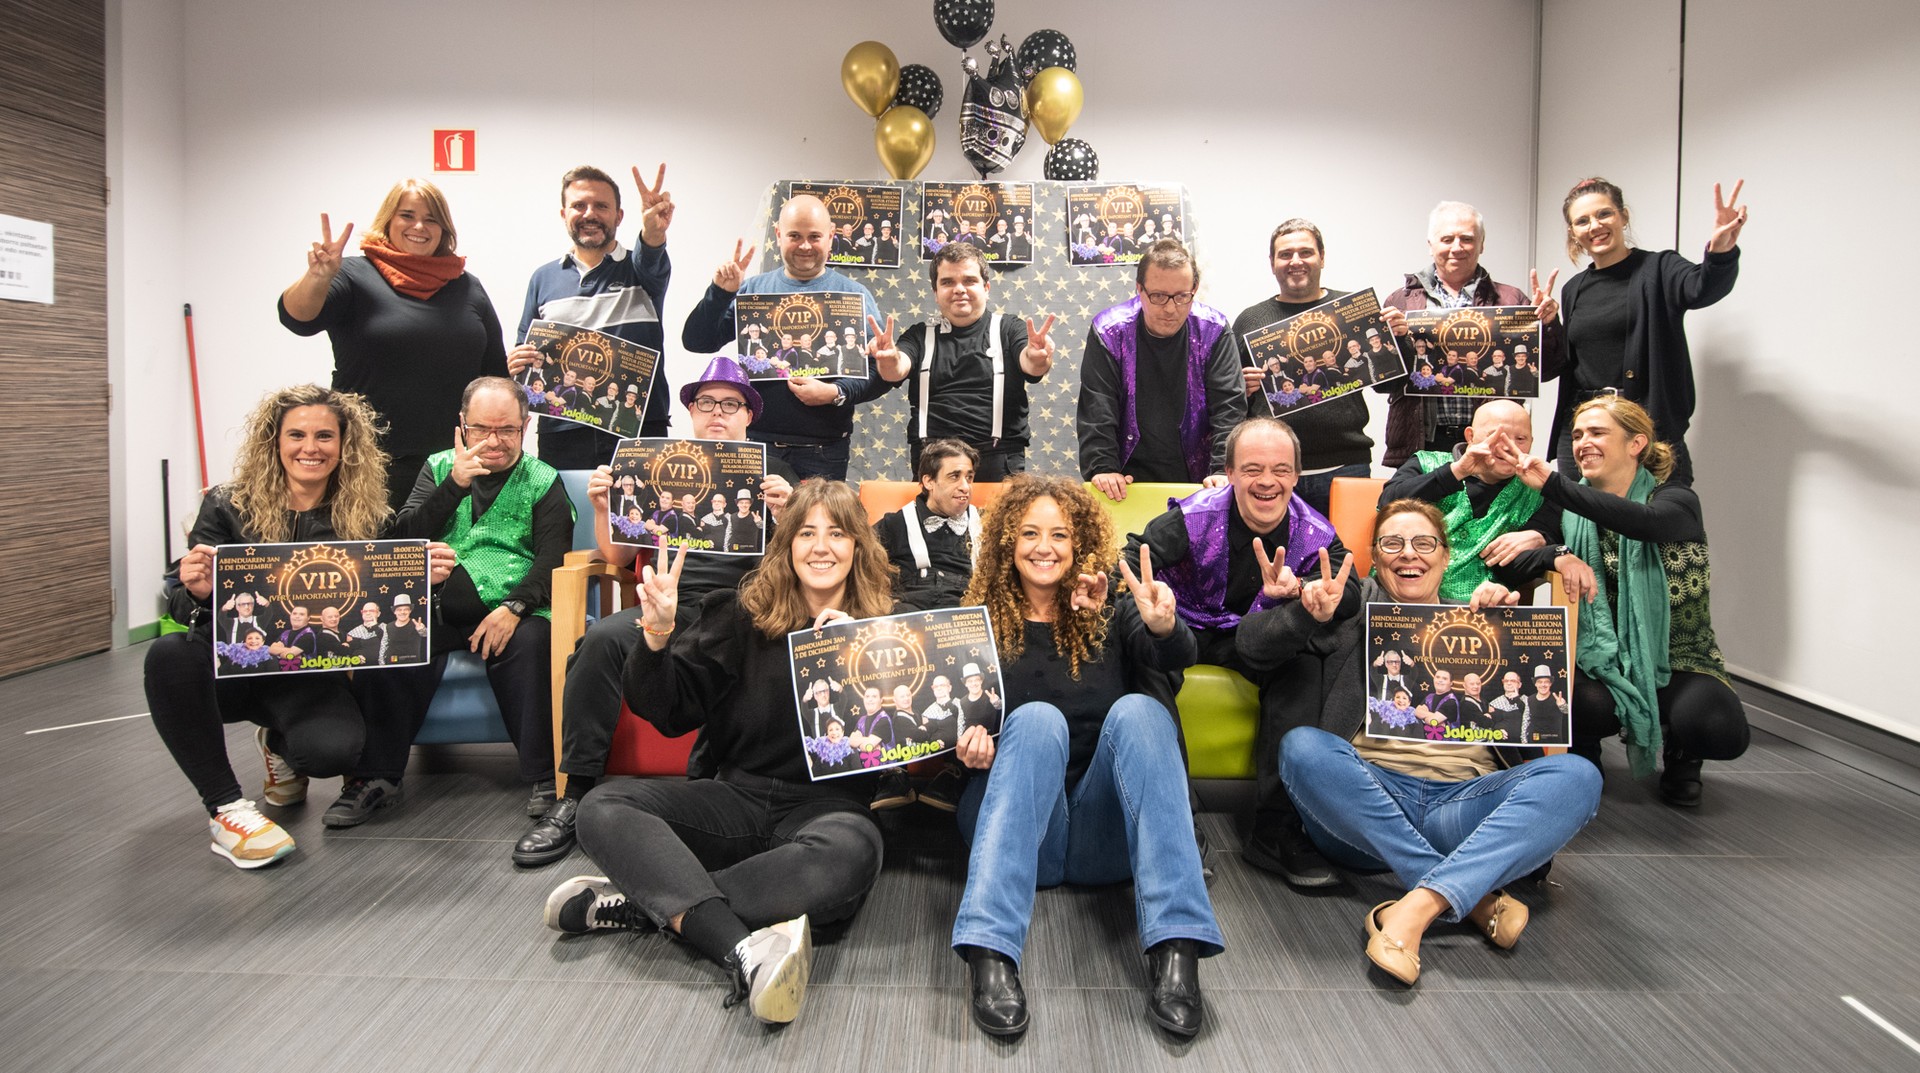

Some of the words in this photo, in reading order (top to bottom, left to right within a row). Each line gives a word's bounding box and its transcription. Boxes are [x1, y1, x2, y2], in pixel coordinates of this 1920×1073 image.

[832, 202, 855, 214] VIP
[965, 200, 988, 211] VIP
[1111, 202, 1134, 213] VIP
[786, 311, 812, 323] VIP
[1299, 327, 1327, 345] VIP
[1452, 327, 1479, 339] VIP
[576, 348, 603, 365] VIP
[1321, 380, 1360, 399] Jalgune
[1453, 386, 1493, 396] Jalgune
[561, 407, 601, 425] Jalgune
[667, 463, 698, 479] VIP
[667, 536, 711, 548] Jalune
[393, 552, 425, 560] LEKUONA
[299, 571, 342, 591] VIP
[292, 592, 337, 600] IMPORTANT
[924, 622, 953, 632] MANUEL
[953, 619, 985, 628] LEKUONA
[933, 628, 960, 638] KULTUR
[961, 625, 986, 635] ETXEAN
[794, 638, 833, 653] ABENDUAREN
[808, 644, 840, 656] DICIEMBRE
[1440, 635, 1483, 655] VIP
[300, 655, 360, 669] Jalgune
[865, 647, 907, 669] VIP
[1435, 657, 1479, 665] IMPORTANT
[862, 669, 906, 682] IMPORTANT
[1444, 724, 1503, 742] Jalgune
[880, 741, 940, 763] Jalgune
